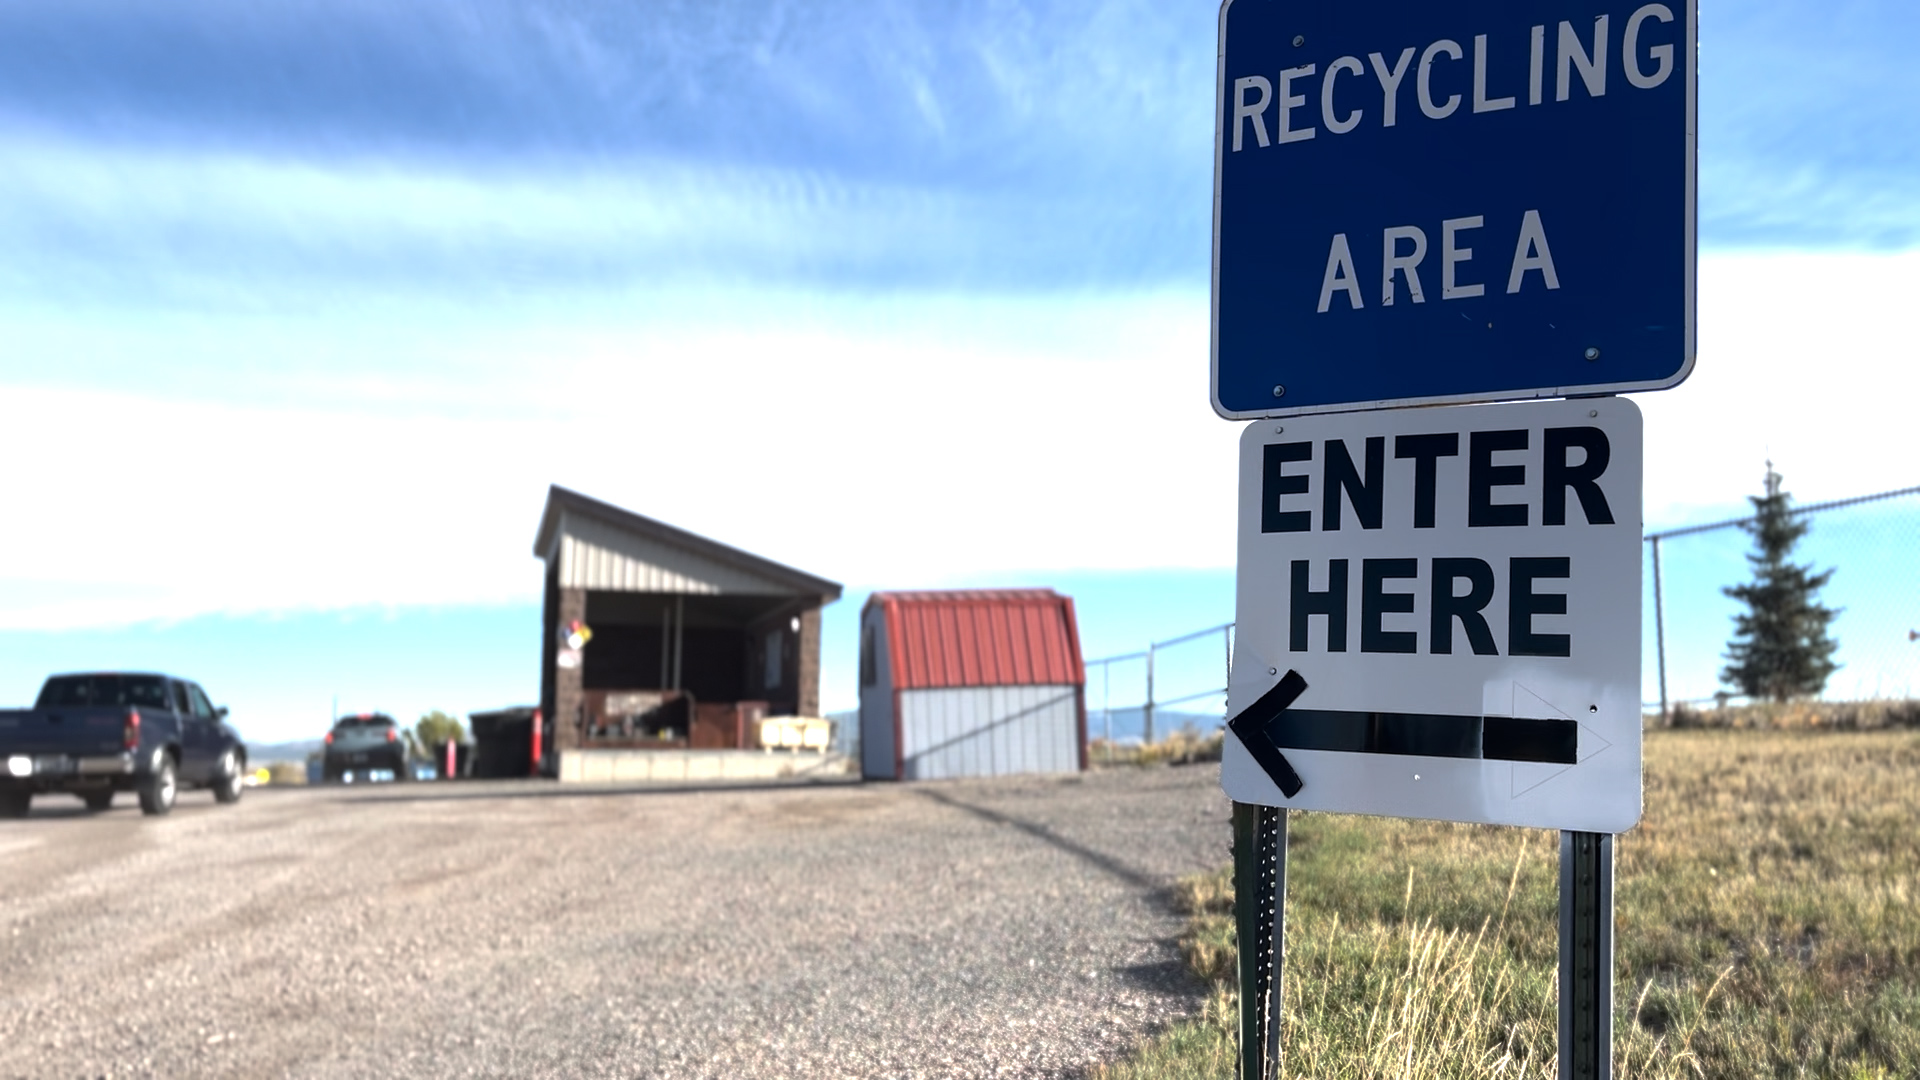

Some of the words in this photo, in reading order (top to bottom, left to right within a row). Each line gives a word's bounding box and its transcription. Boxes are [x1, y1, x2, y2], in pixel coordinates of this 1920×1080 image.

[1232, 3, 1675, 152] RECYCLING
[1316, 209, 1561, 314] AREA
[1261, 426, 1616, 533] ENTER
[1289, 556, 1572, 657] HERE
